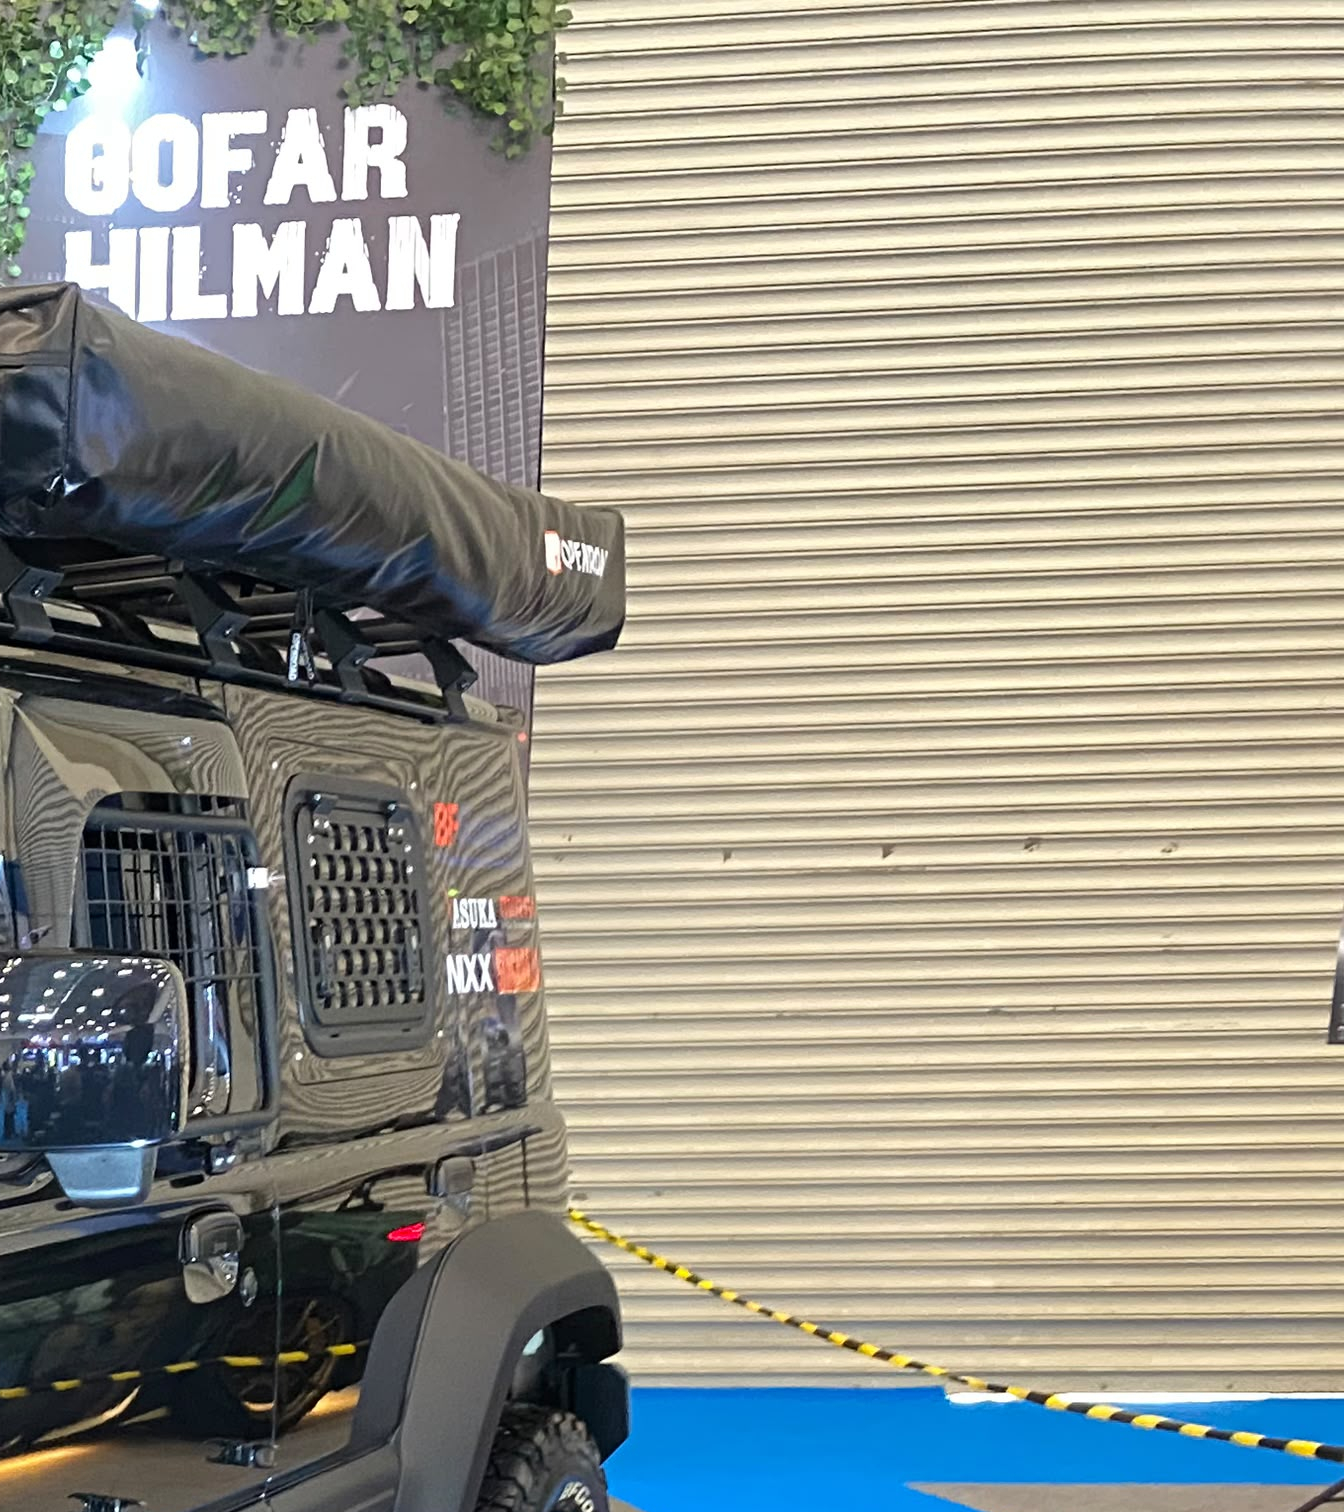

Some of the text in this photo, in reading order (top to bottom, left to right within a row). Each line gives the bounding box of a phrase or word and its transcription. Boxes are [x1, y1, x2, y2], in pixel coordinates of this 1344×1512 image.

[64, 104, 408, 214] GOFAR
[64, 212, 461, 322] HILMAN
[452, 898, 498, 929] ASUKA
